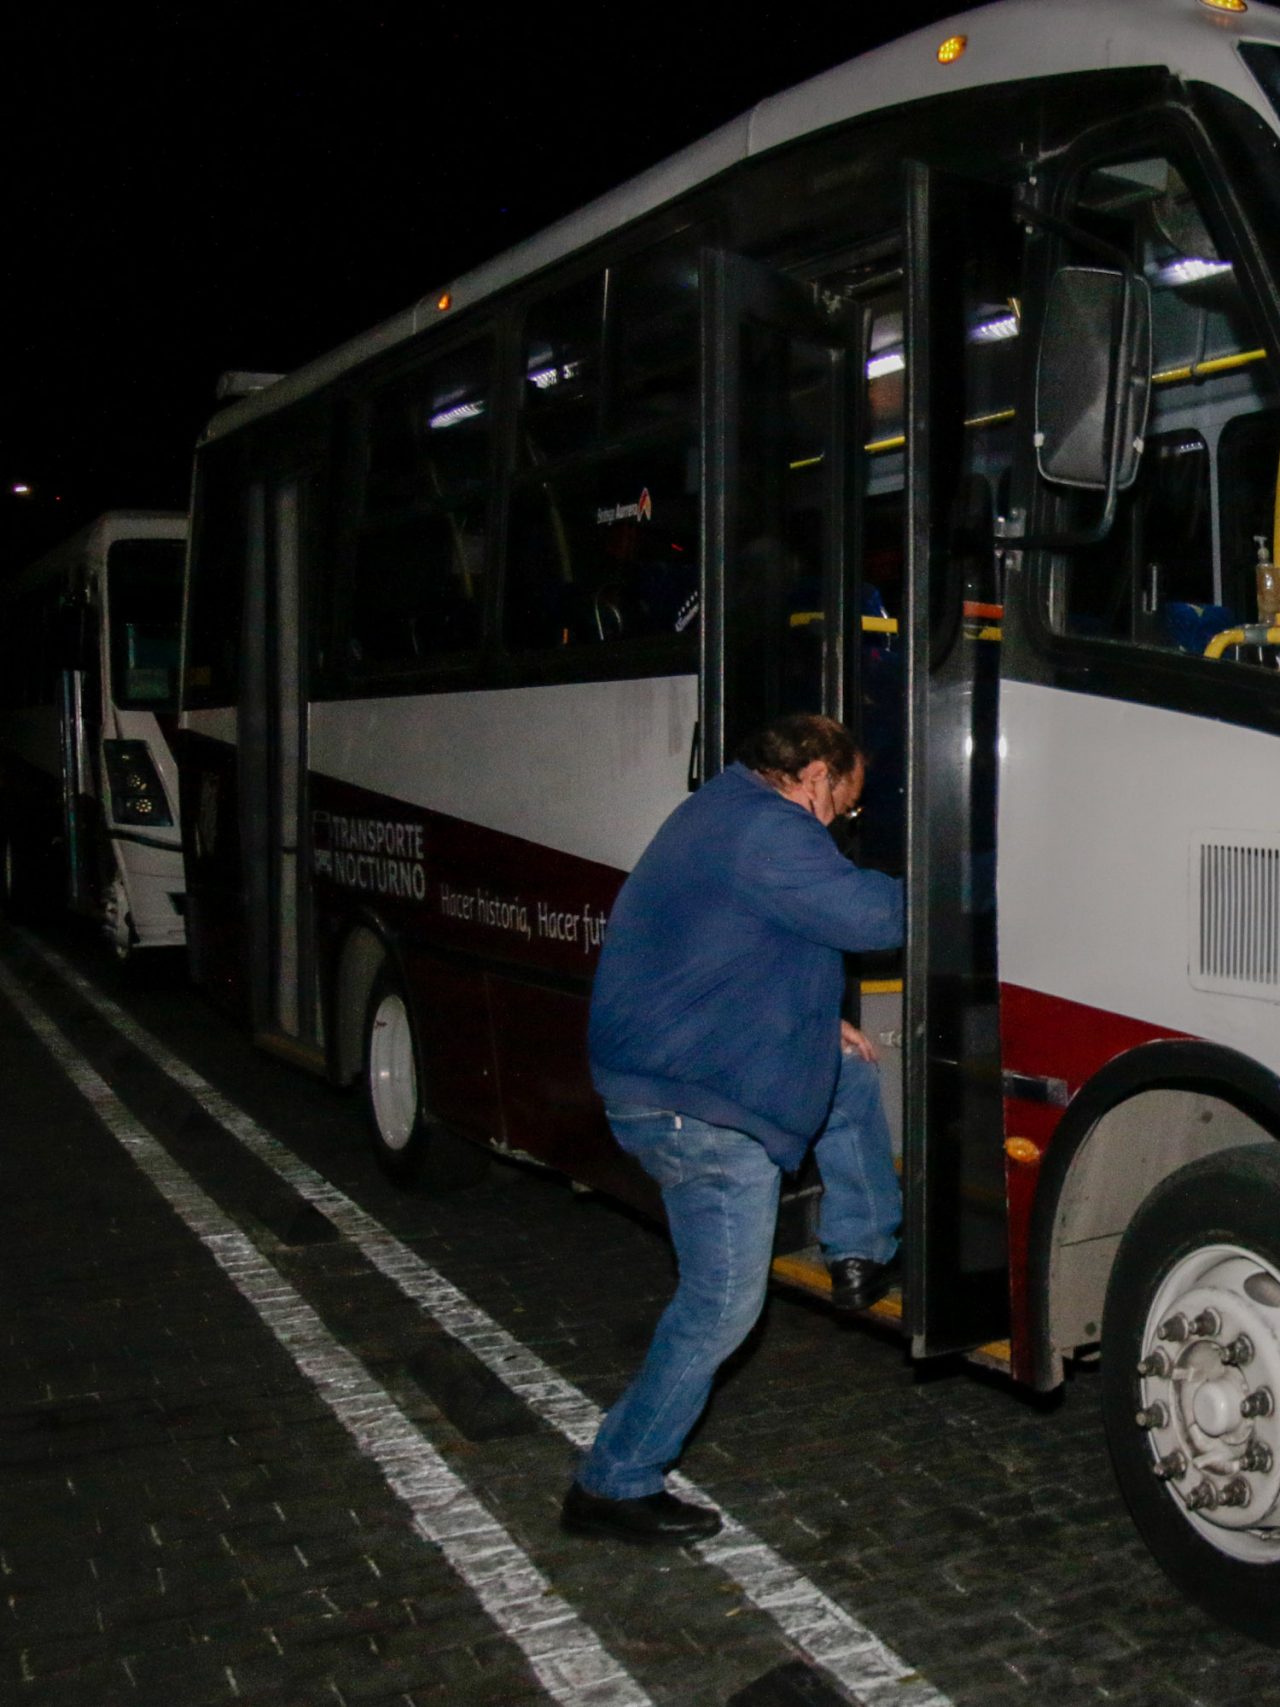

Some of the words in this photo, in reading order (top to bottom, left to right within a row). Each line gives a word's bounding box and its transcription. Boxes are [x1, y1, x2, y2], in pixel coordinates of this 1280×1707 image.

[332, 815, 425, 860] TRANSPORTE
[334, 850, 426, 900] NOCTURNO
[440, 881, 475, 920] Hacer
[536, 901, 580, 942] Hacer
